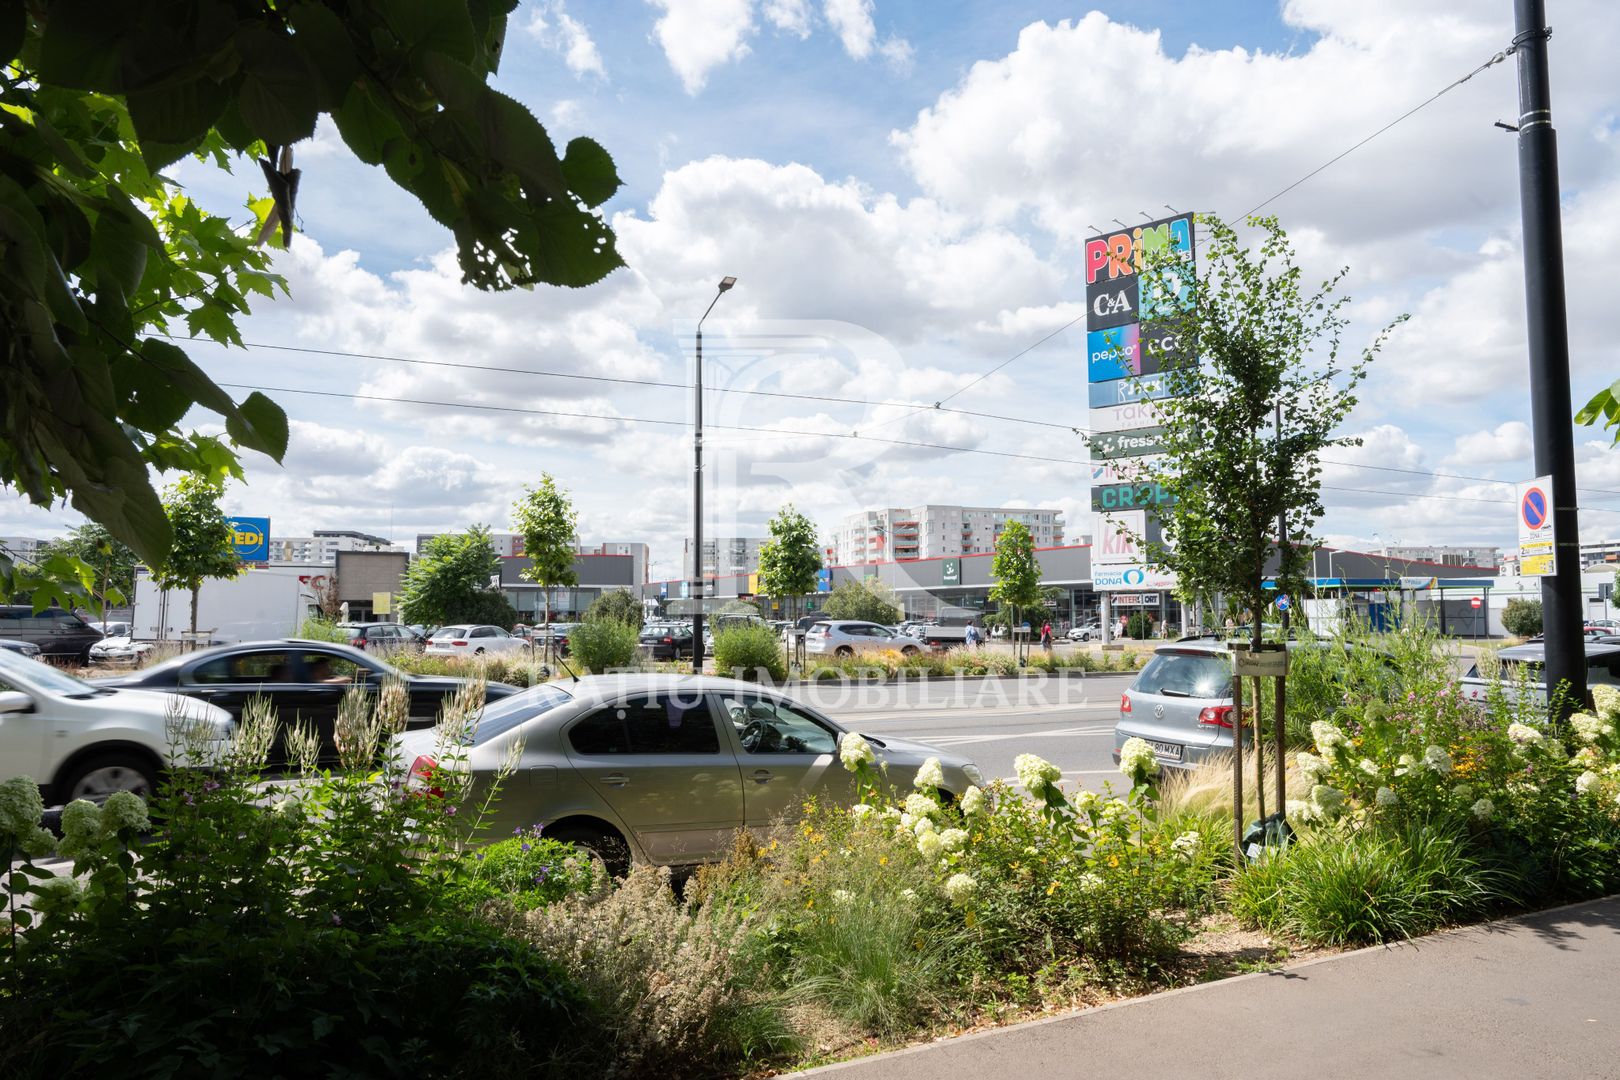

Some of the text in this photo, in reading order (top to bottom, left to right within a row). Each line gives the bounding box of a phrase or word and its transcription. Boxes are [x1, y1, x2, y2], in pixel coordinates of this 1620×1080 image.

[1093, 290, 1132, 316] C&A
[1102, 482, 1179, 508] CROP
[1095, 577, 1122, 586] DONA
[1117, 595, 1158, 604] INTERSORT
